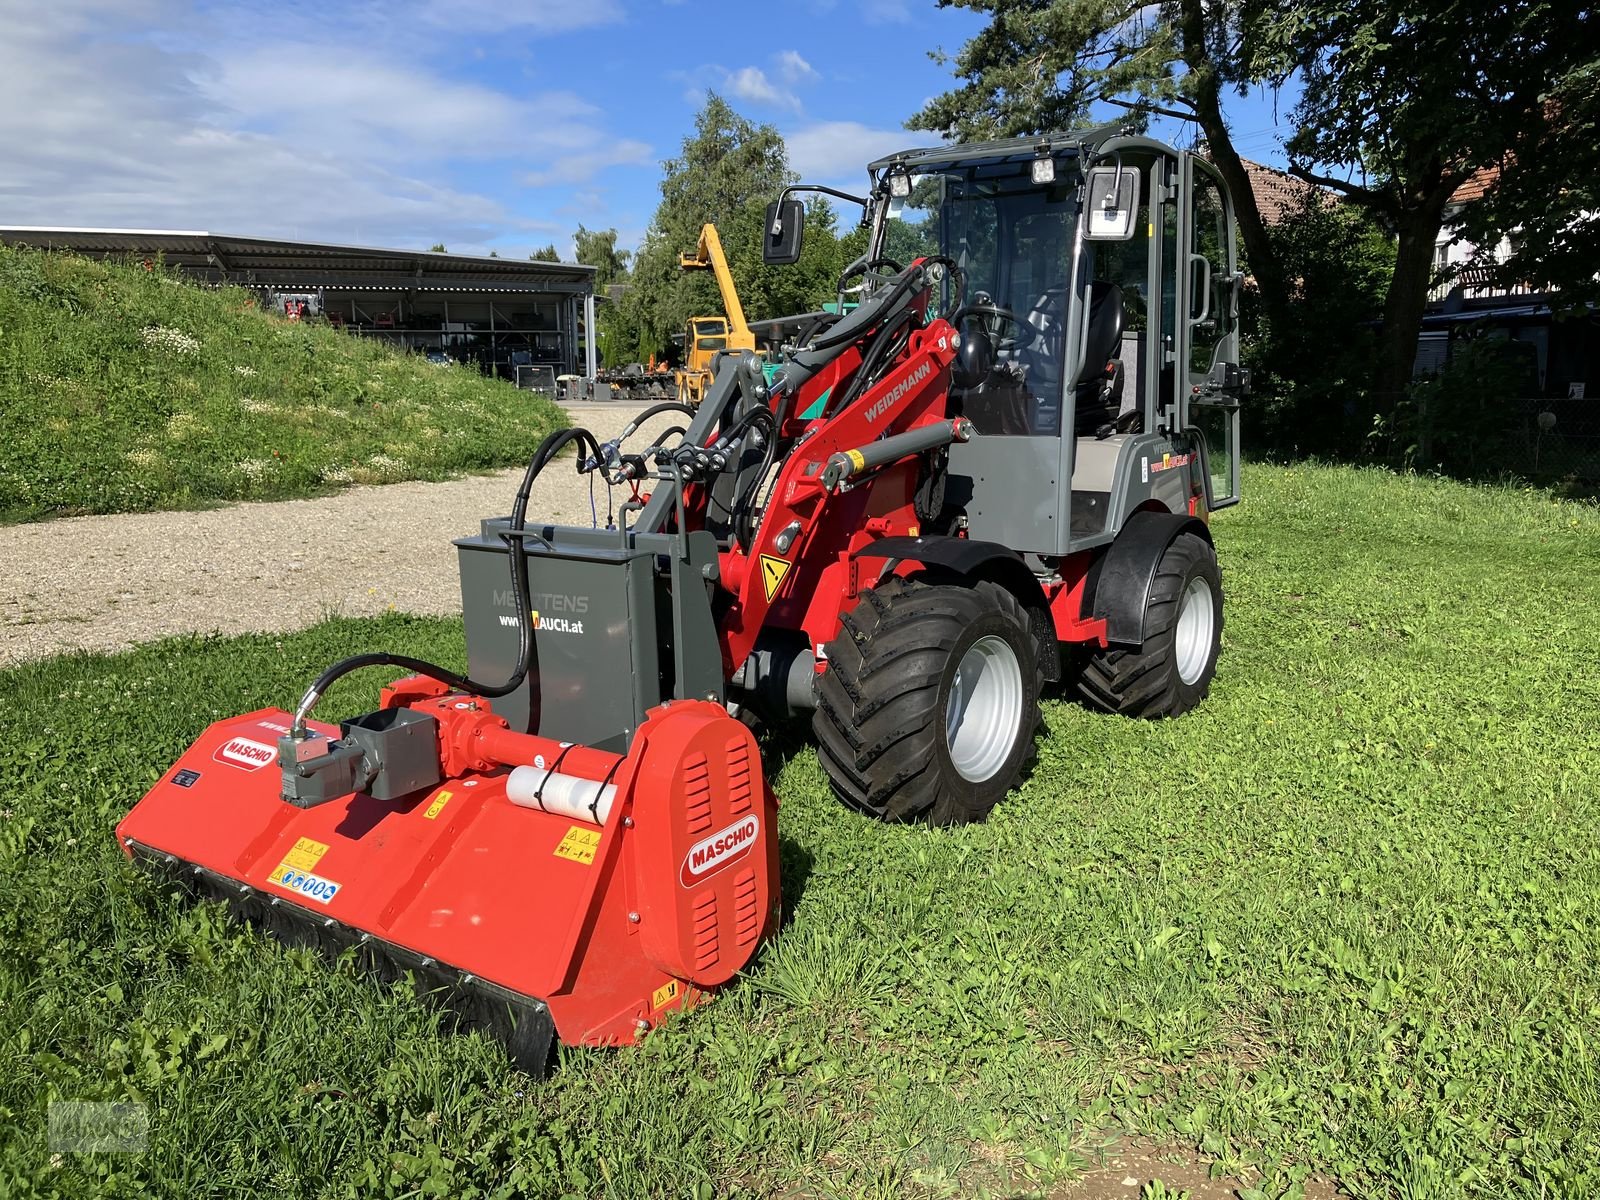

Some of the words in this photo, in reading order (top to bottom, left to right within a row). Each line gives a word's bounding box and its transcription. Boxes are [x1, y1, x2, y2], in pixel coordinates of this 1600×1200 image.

[864, 361, 931, 423] WEIDEMANN
[227, 742, 273, 763] MASCHIO
[692, 821, 755, 869] MASCHIO
